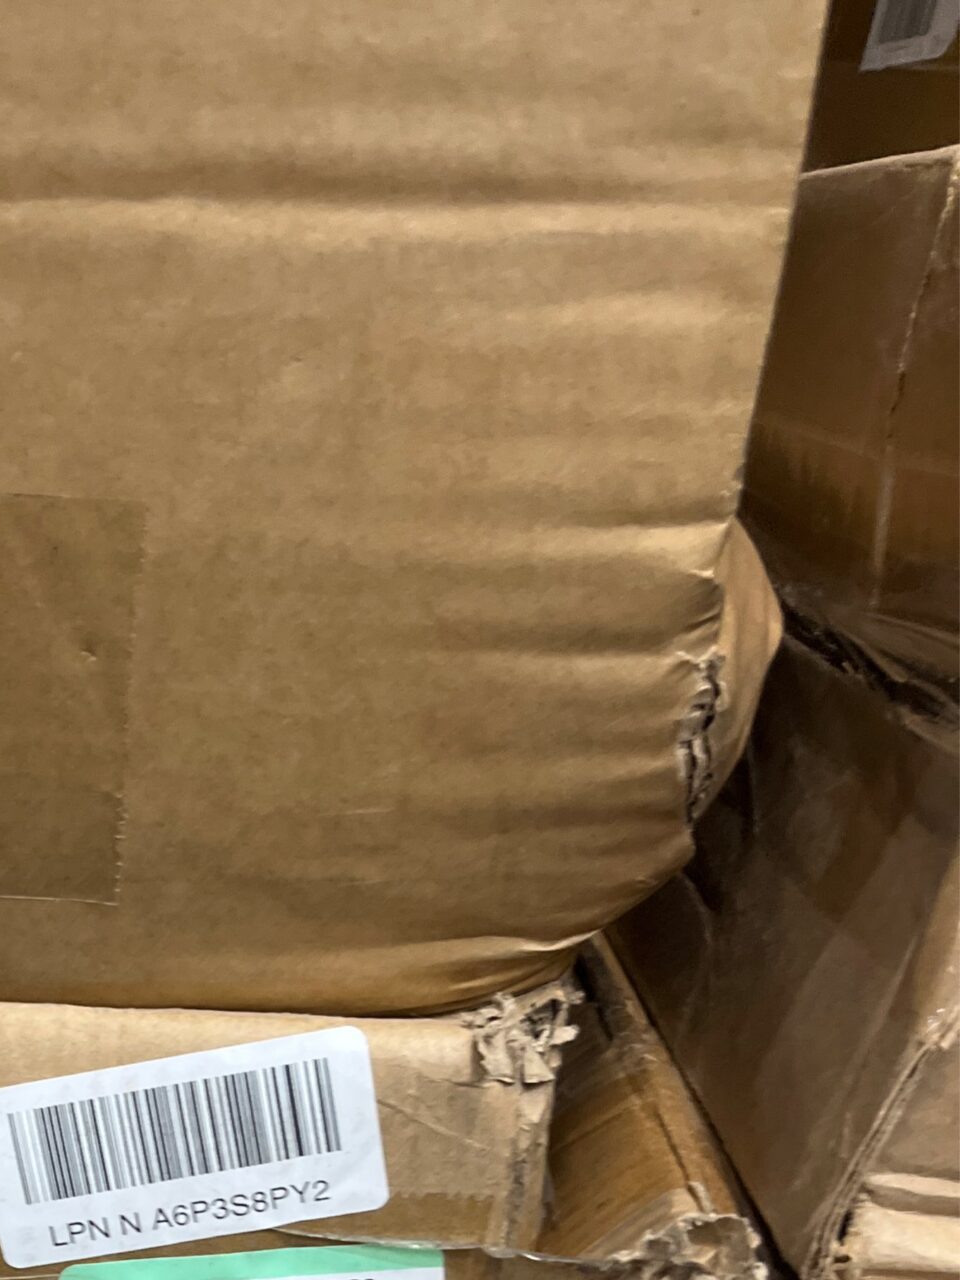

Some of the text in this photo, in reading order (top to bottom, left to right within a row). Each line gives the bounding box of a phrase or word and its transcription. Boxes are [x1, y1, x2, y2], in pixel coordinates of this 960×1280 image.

[48, 1179, 331, 1247] LPN N A6P3S8PY2
